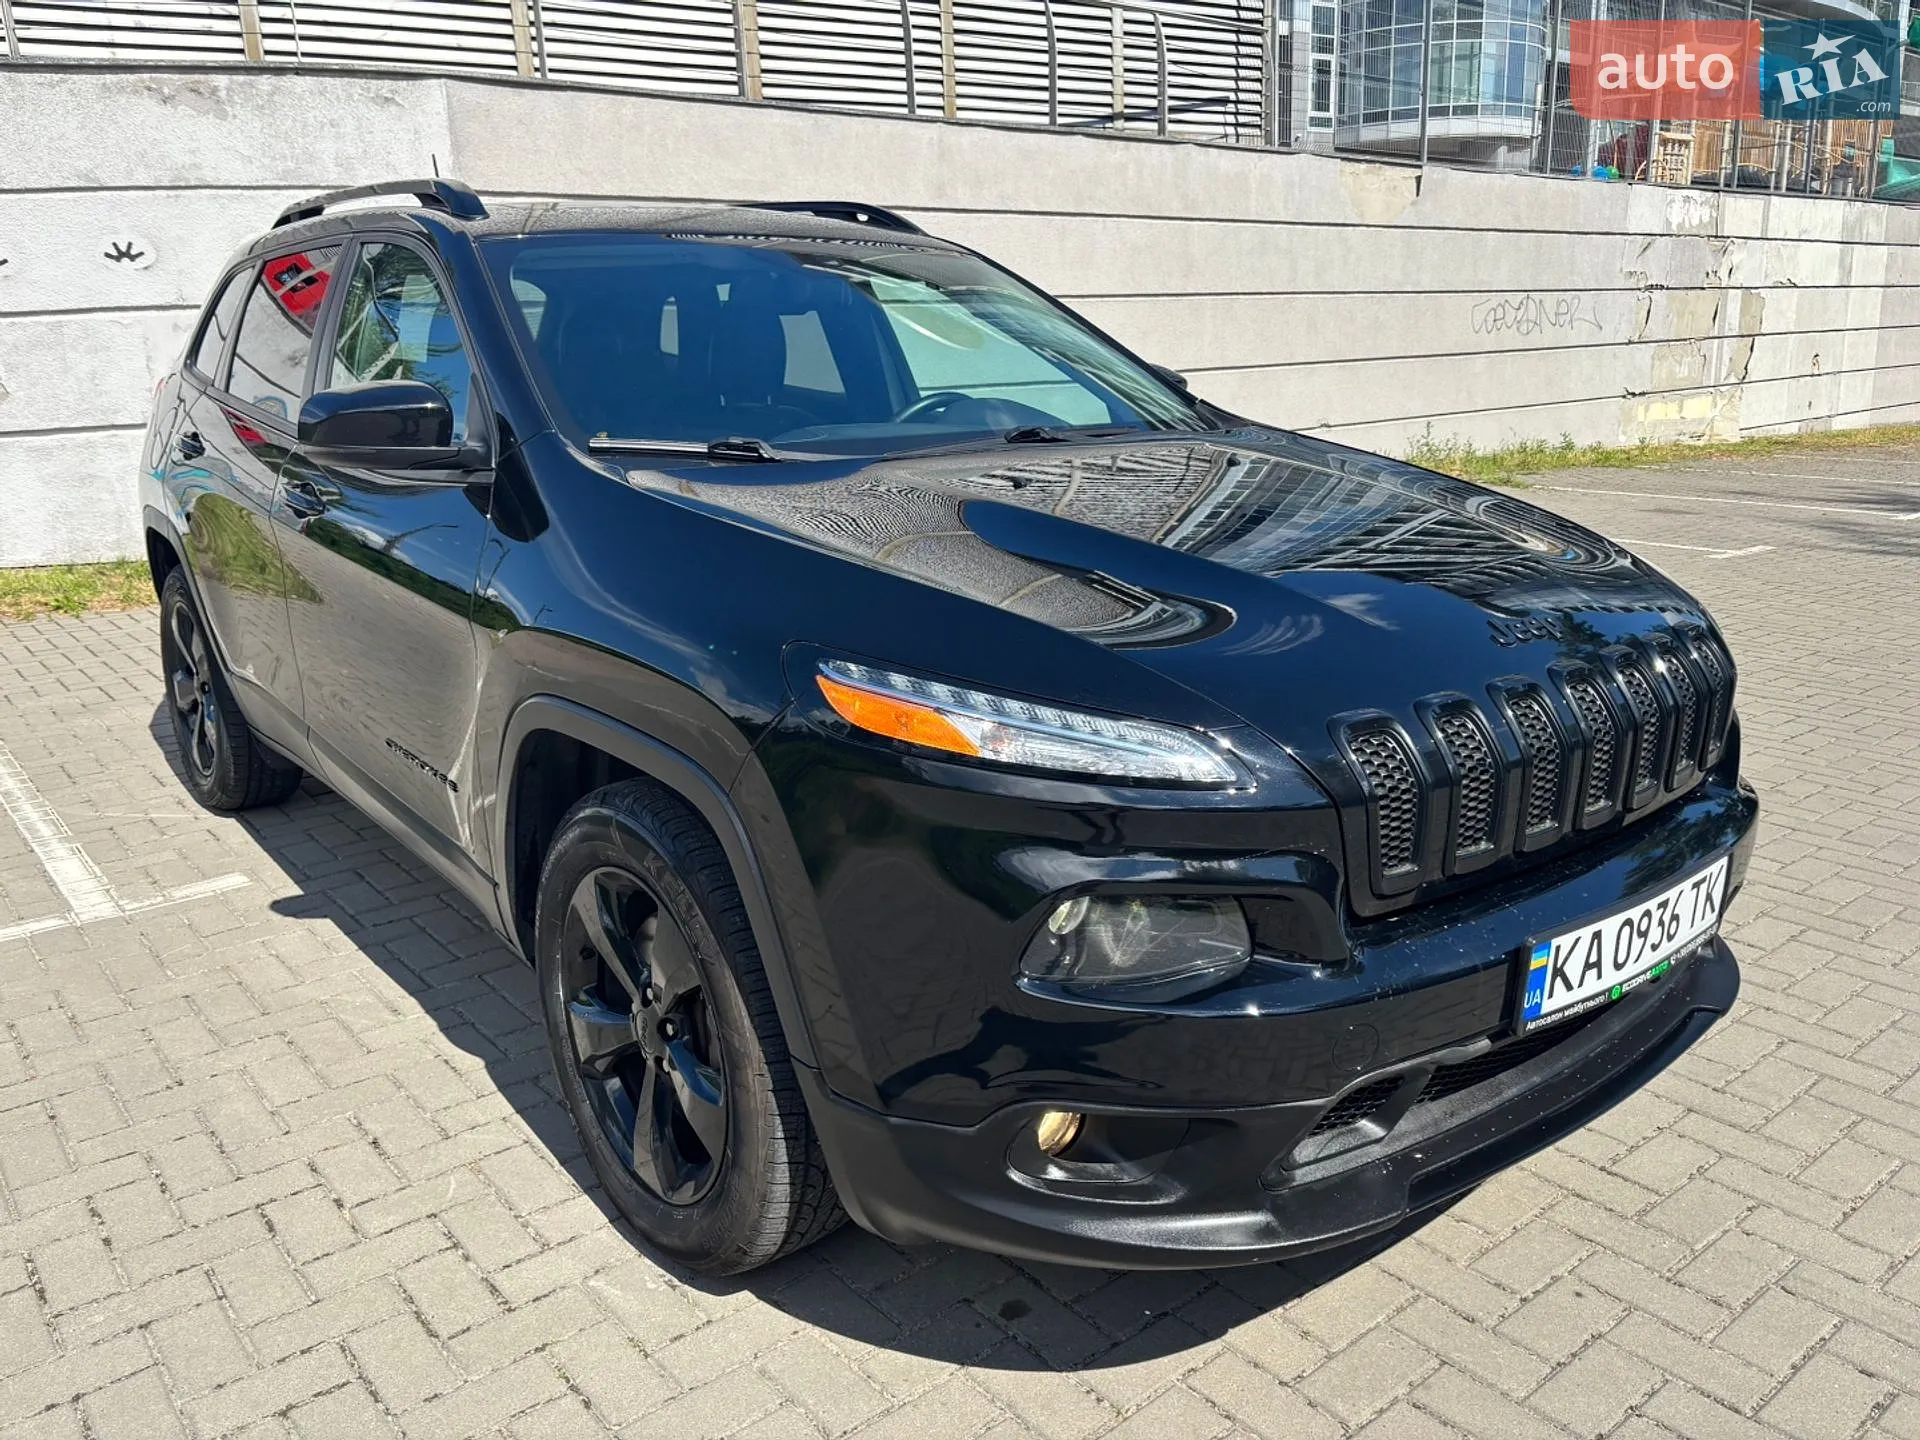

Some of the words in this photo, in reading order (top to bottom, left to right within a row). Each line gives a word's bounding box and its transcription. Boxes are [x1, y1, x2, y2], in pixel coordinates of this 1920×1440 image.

[1547, 928, 1603, 1000] KA
[1613, 889, 1685, 972] 0936
[1689, 864, 1724, 930] TK
[1524, 988, 1541, 1008] UA
